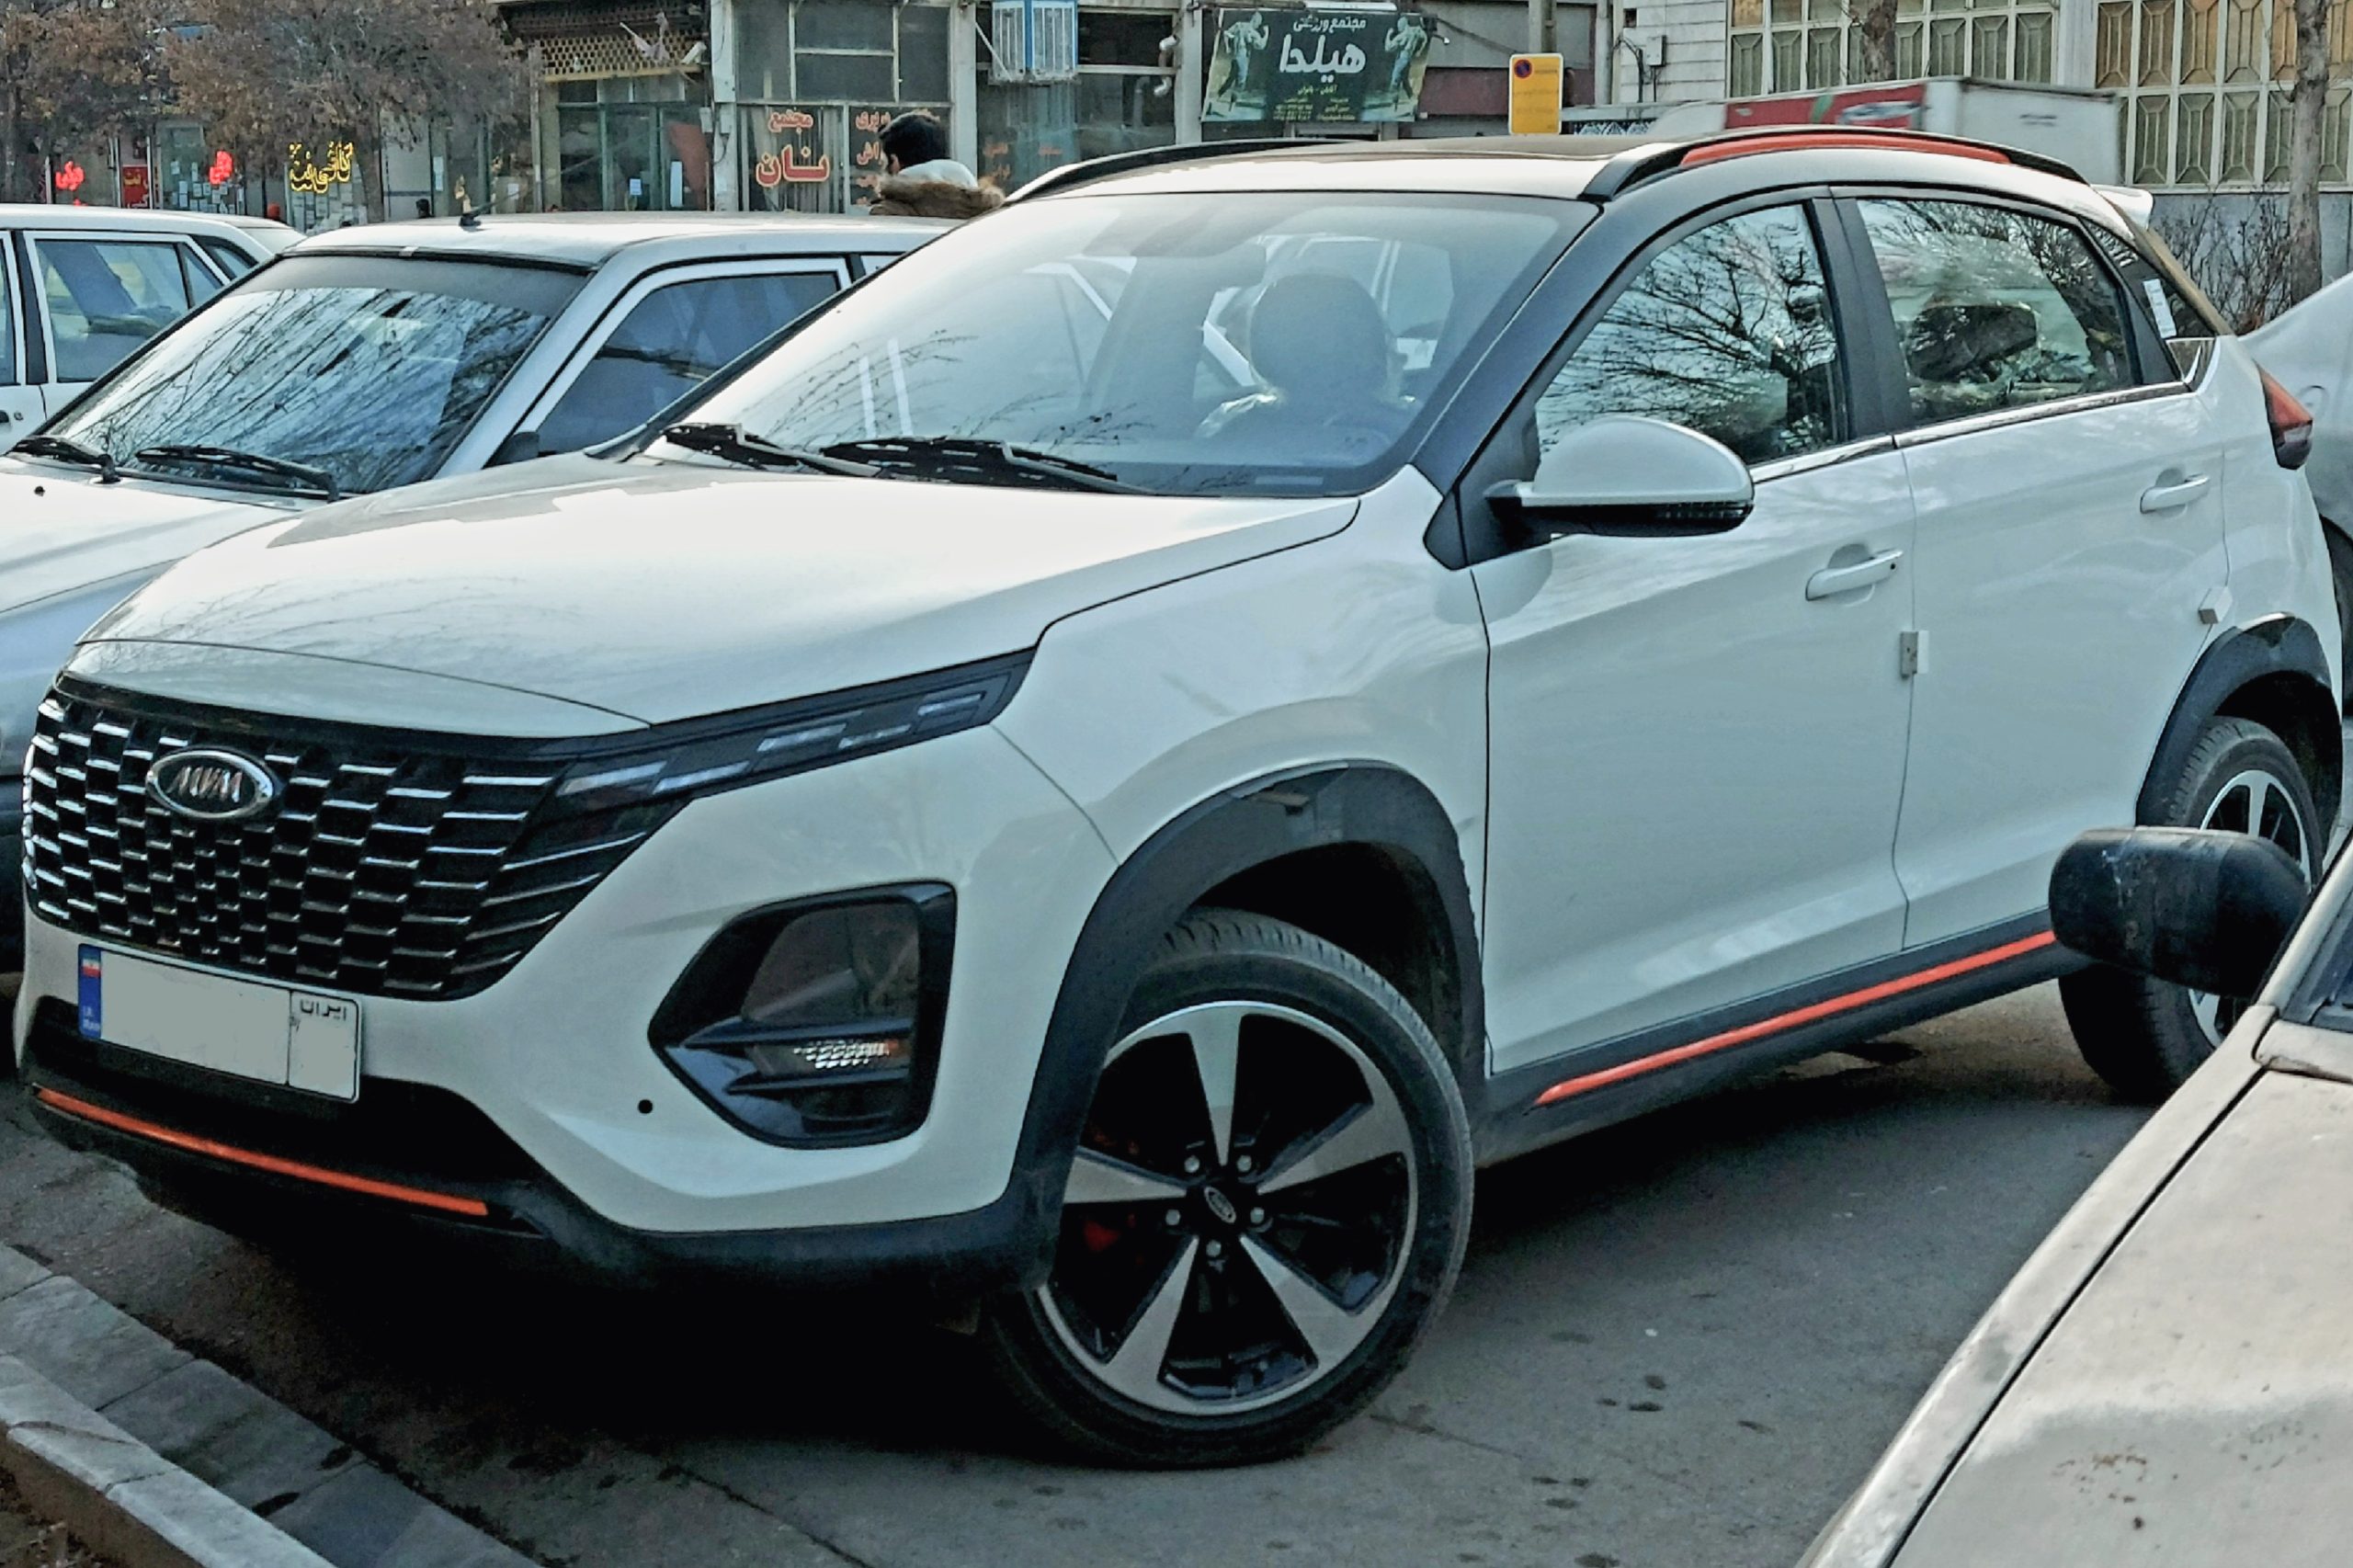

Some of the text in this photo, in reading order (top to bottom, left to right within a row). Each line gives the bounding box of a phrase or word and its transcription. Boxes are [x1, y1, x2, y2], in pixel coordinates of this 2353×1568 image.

[1293, 14, 1366, 33] مجتمع ورزشی
[1279, 33, 1366, 84] هیلدا
[767, 108, 814, 134] مجتمع
[289, 143, 314, 192] نت
[312, 139, 355, 194] کافی
[756, 143, 831, 188] نان
[300, 997, 347, 1022] ایران
